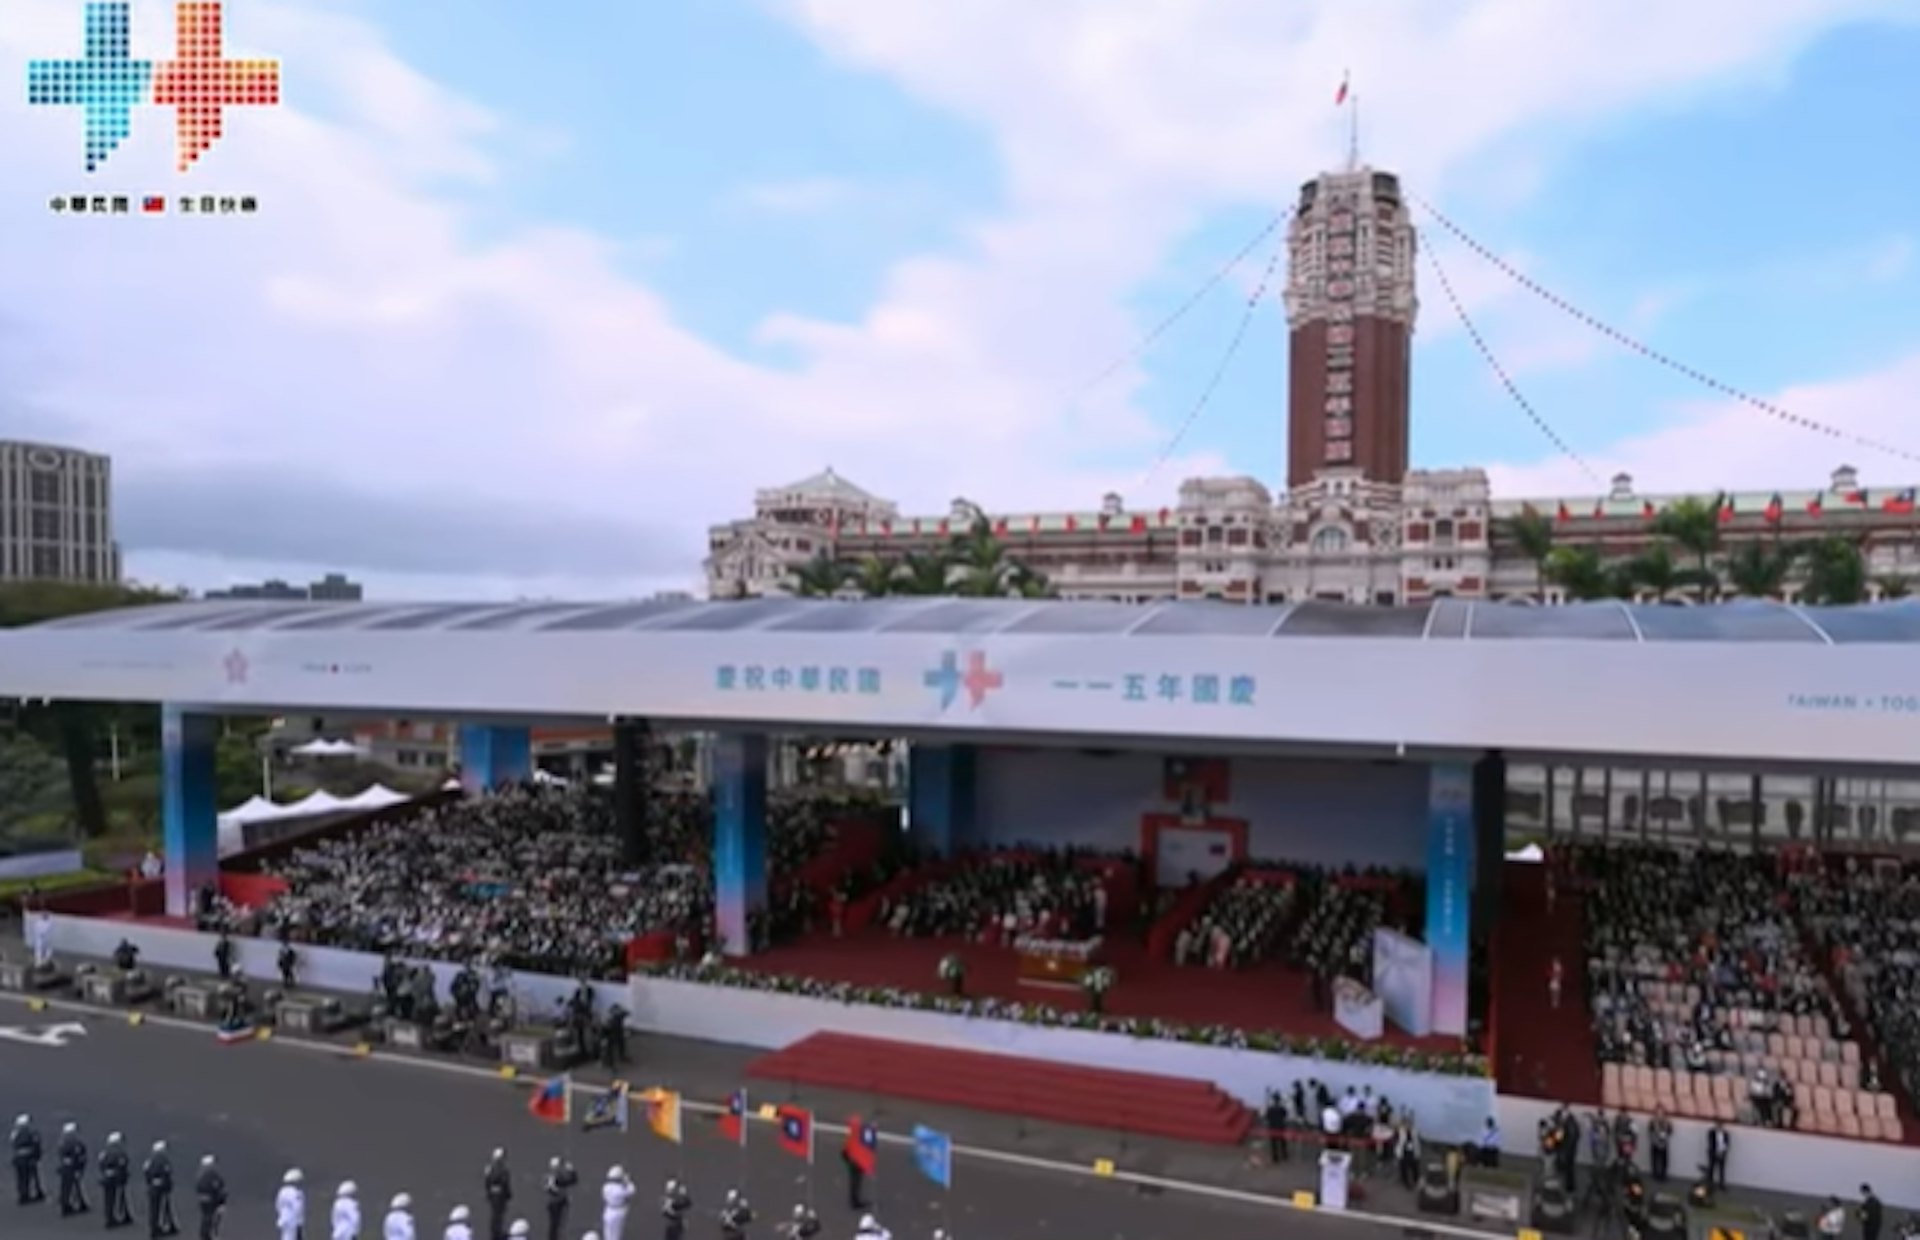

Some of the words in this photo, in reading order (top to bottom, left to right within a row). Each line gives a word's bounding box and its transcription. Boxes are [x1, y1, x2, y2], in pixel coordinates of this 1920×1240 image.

[716, 665, 881, 694] 慶祝中華民國
[1052, 671, 1257, 706] 一一五年國慶
